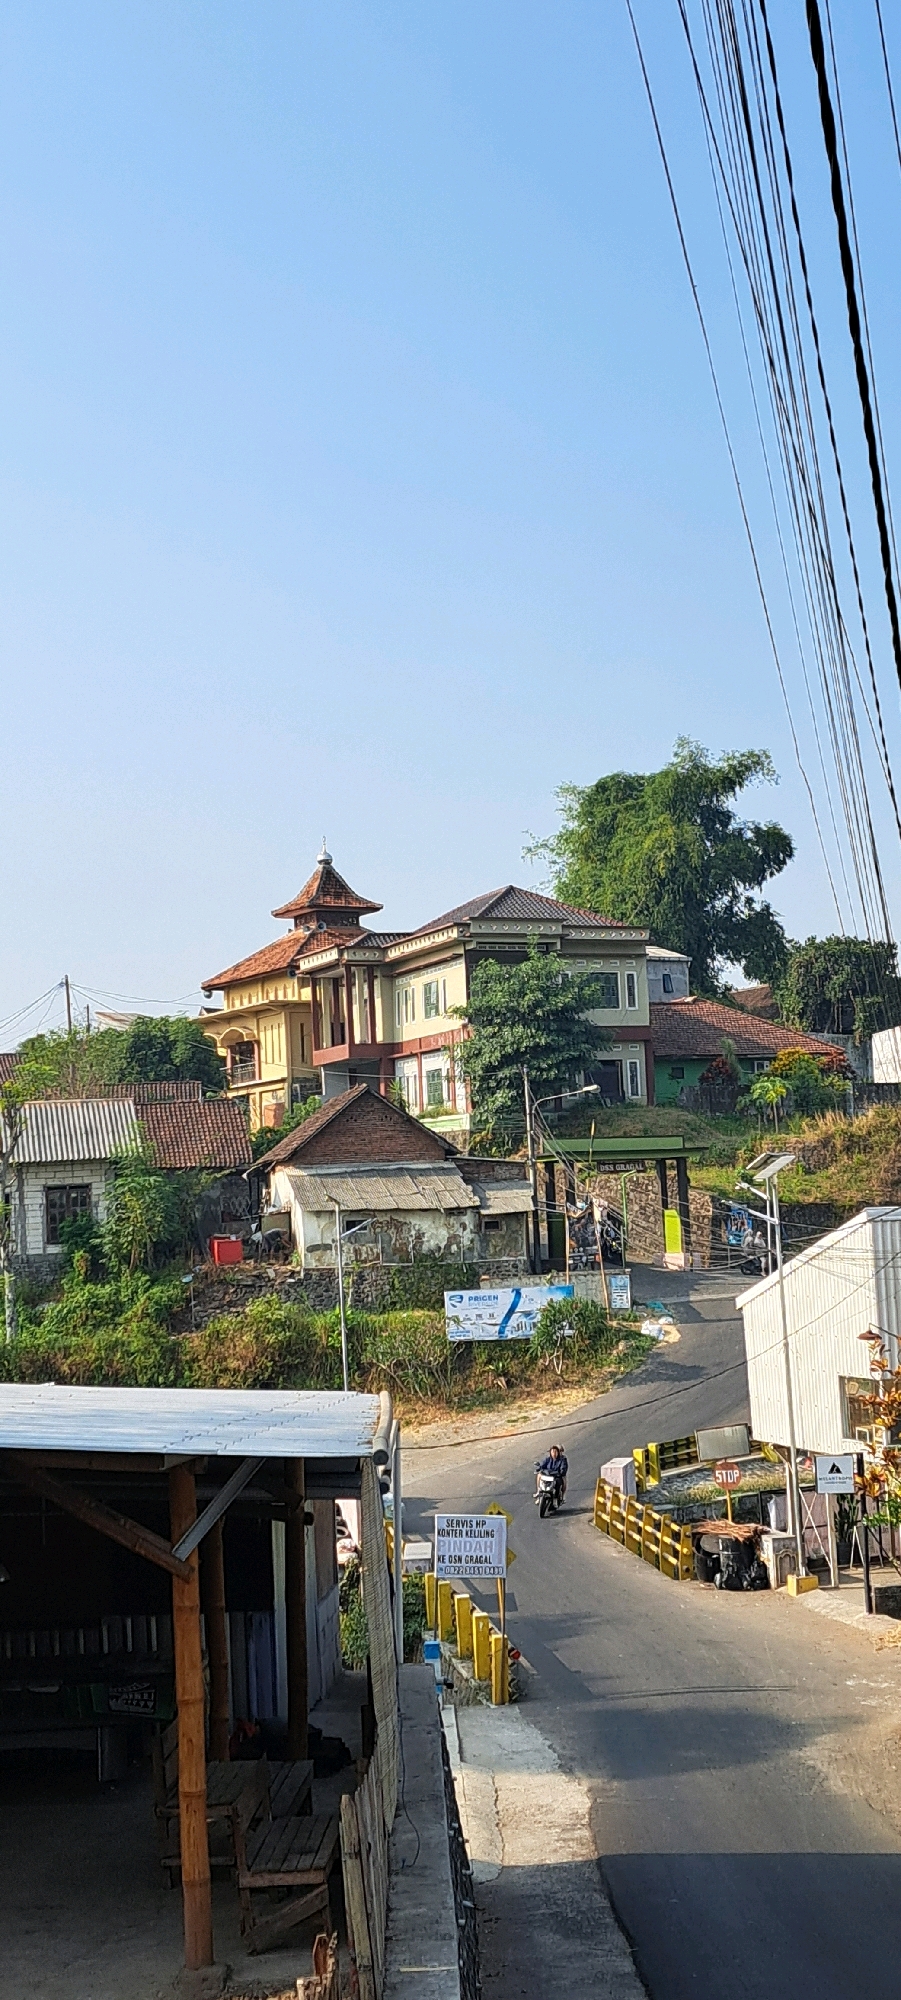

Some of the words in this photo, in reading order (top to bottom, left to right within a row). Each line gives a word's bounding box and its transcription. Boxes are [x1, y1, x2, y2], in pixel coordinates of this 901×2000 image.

[715, 1470, 740, 1483] STOP
[446, 1519, 473, 1528] SERVIS
[475, 1520, 487, 1528] HP
[438, 1529, 463, 1538] KONTER
[465, 1529, 495, 1538] KELILING
[438, 1540, 494, 1553] PINDAH
[438, 1555, 446, 1564] KE
[448, 1555, 462, 1564] DSN
[465, 1555, 492, 1564] GRAGAL
